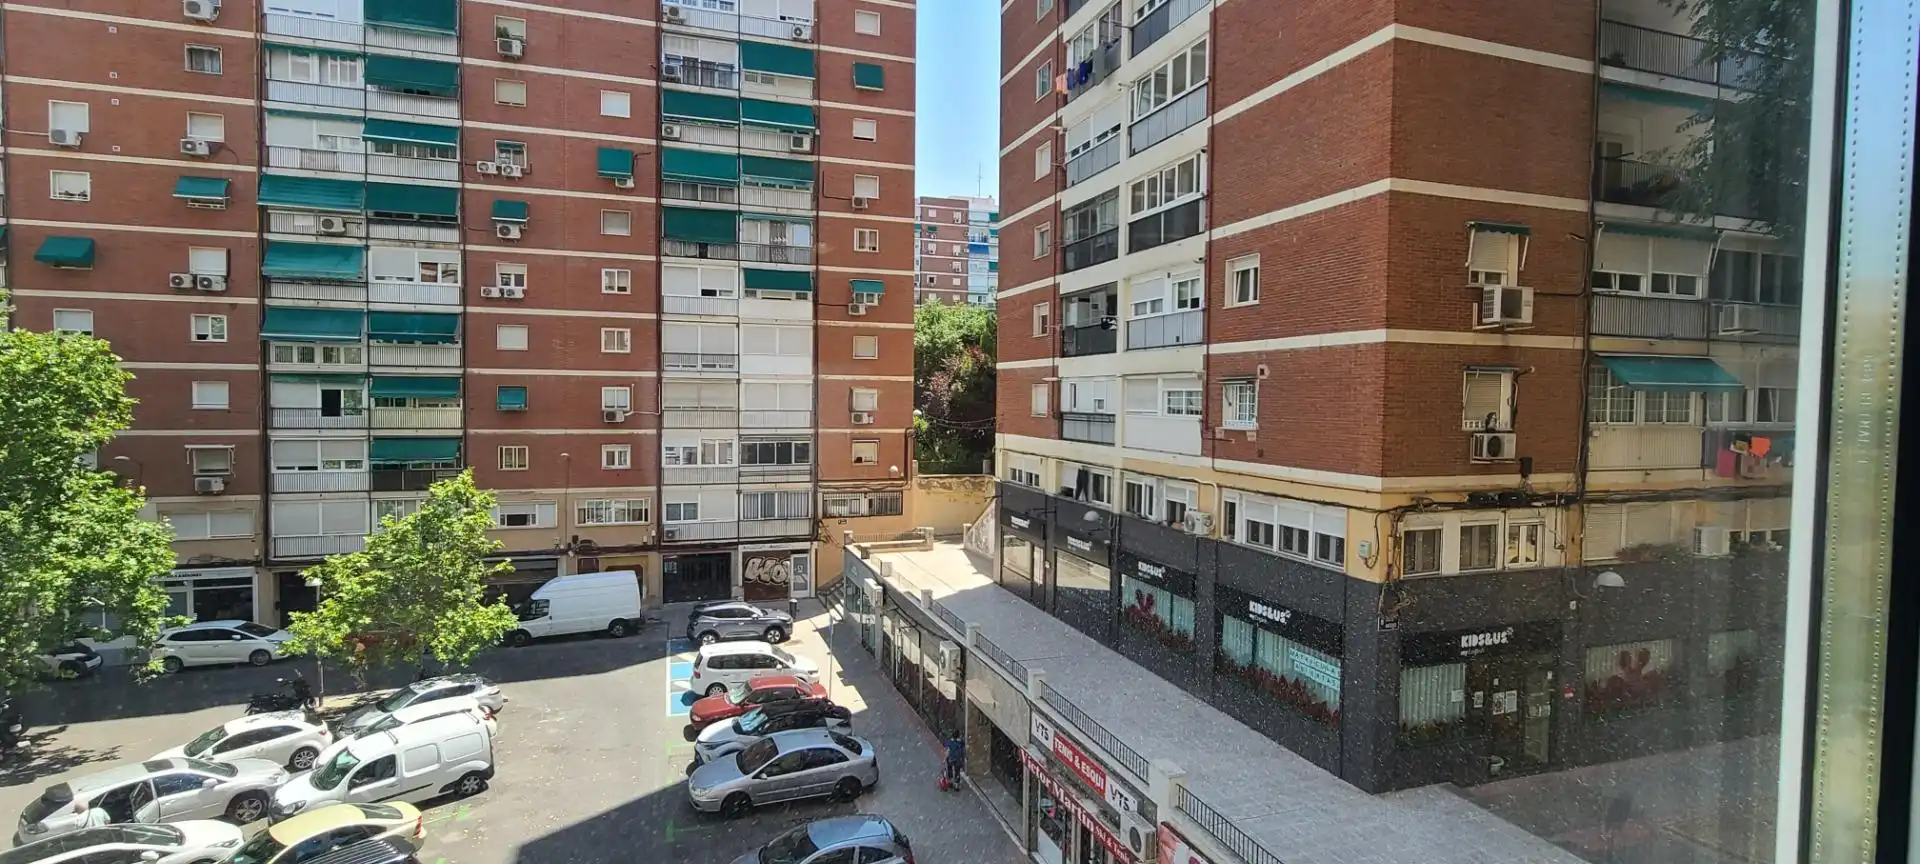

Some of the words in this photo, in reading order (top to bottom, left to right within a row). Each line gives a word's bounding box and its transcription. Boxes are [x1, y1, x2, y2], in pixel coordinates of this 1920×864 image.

[1461, 631, 1509, 648] KIDS&US
[1035, 718, 1049, 741] VTS
[1055, 737, 1073, 763] TENIS
[1074, 754, 1081, 769] &
[1081, 761, 1104, 790] ESQUI
[1020, 749, 1051, 789] Victor
[1053, 780, 1094, 832] Martin
[1109, 783, 1131, 811] VTS
